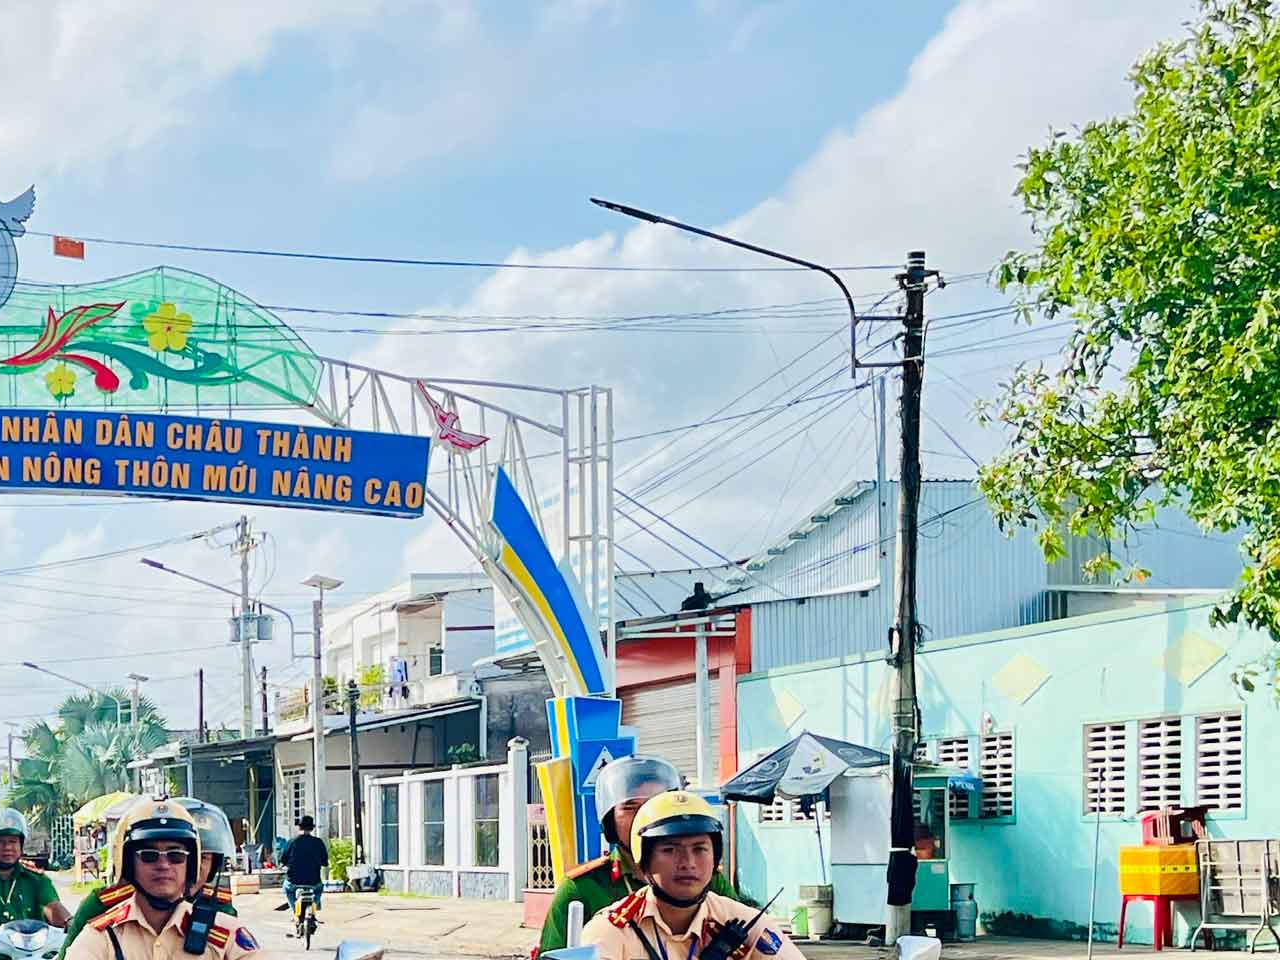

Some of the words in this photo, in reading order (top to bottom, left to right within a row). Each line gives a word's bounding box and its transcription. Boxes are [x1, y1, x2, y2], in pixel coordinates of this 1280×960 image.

[1, 411, 83, 443] NHÂN
[96, 414, 153, 447] DÂN
[166, 419, 242, 453] CHÂU
[256, 425, 353, 463] THÀNH
[22, 452, 101, 485] NÔNG
[114, 456, 190, 489] THÔN
[203, 461, 256, 493] MỚI
[271, 467, 352, 502] NÂNG
[364, 478, 424, 509] CAO
